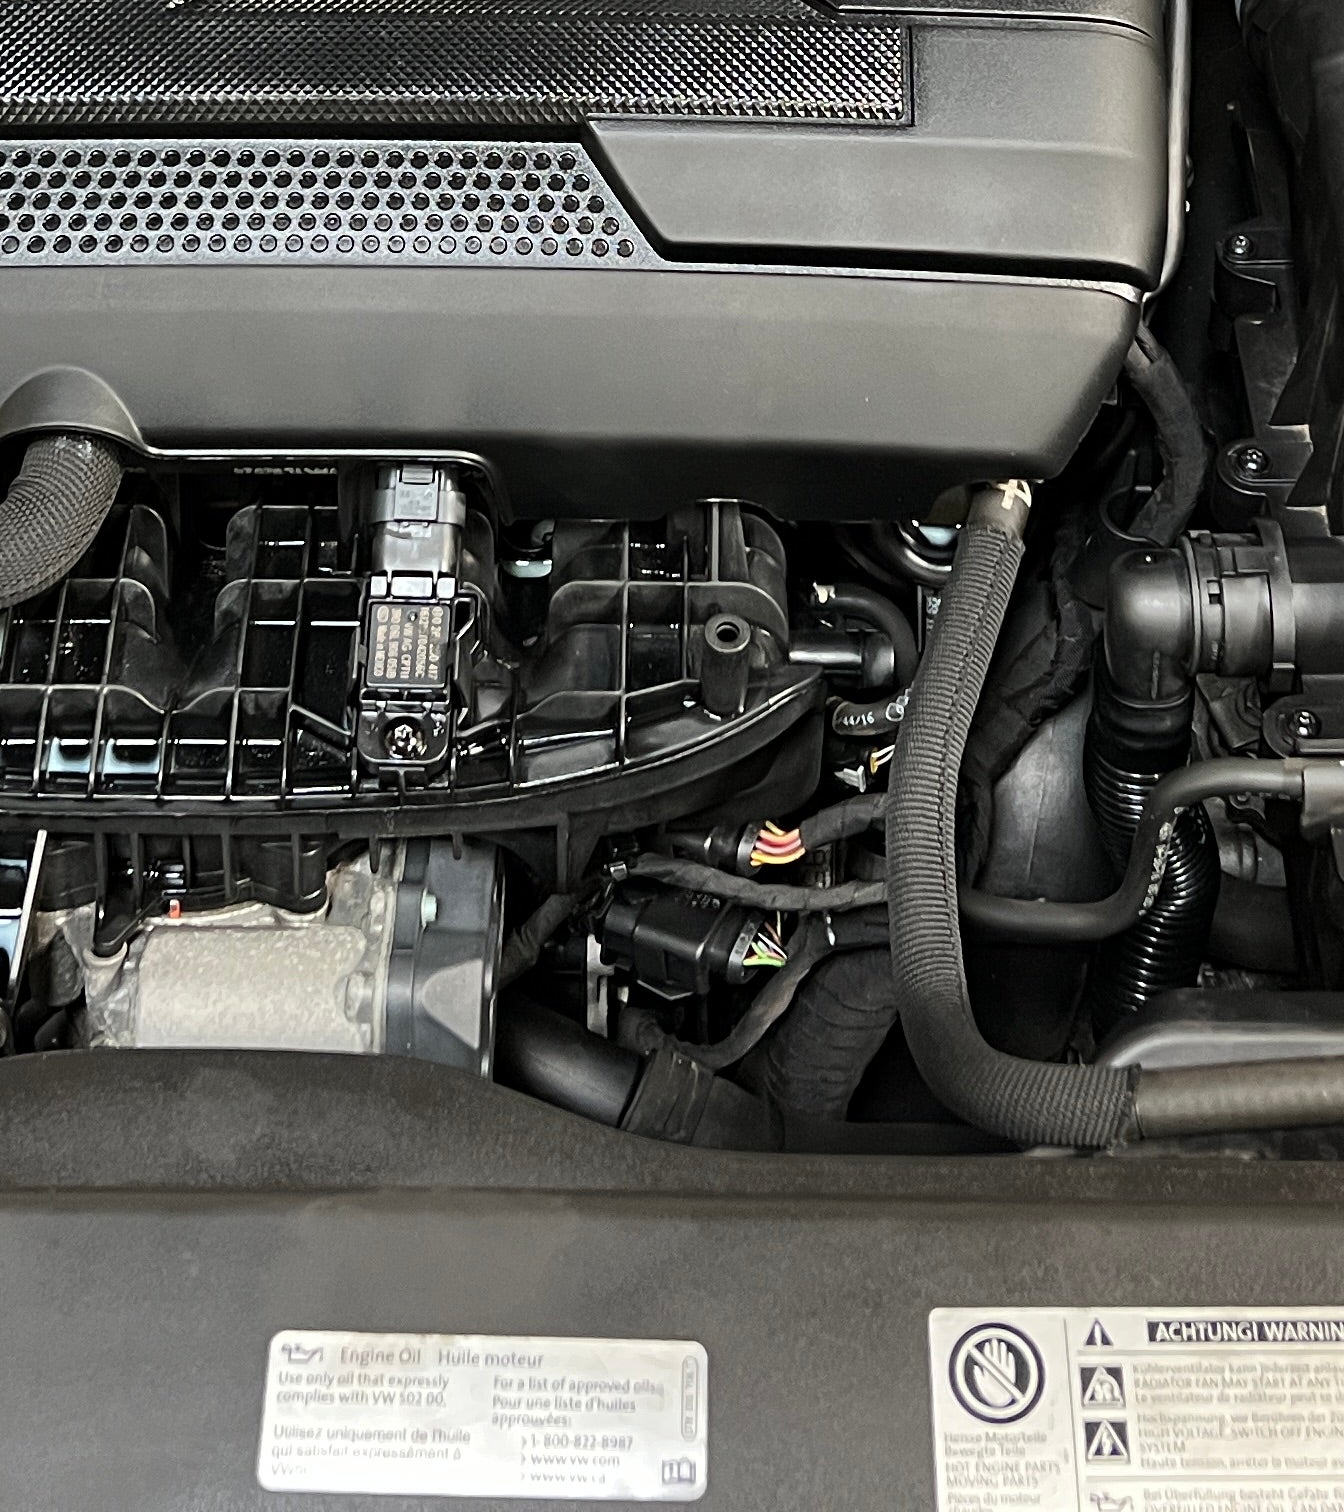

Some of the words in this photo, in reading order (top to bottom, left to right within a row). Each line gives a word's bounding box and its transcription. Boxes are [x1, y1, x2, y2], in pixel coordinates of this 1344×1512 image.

[1156, 1321, 1258, 1342] ACHTUNG!
[340, 1346, 394, 1367] Engine
[398, 1347, 420, 1365] Oil
[437, 1348, 479, 1366] Huile
[484, 1352, 544, 1368] moteur
[278, 1371, 302, 1385] Use
[305, 1371, 334, 1389] only
[336, 1371, 354, 1385] oil
[357, 1372, 384, 1386] that
[387, 1373, 449, 1391] expressly
[493, 1375, 513, 1390] For
[517, 1379, 525, 1390] a
[528, 1376, 548, 1391] list
[551, 1376, 566, 1391] of
[568, 1377, 630, 1395] approved
[276, 1389, 335, 1407] complies
[338, 1389, 369, 1405] with
[372, 1391, 395, 1405] VW
[398, 1391, 422, 1406] 502
[492, 1394, 523, 1409] Pour
[526, 1397, 550, 1410] une
[554, 1395, 582, 1410] liste
[585, 1396, 636, 1412] d'huiles
[273, 1423, 323, 1440] Utilisez
[325, 1425, 406, 1443] uniquement
[410, 1428, 427, 1444] de
[271, 1444, 292, 1459] qui
[296, 1444, 347, 1457] satisfait
